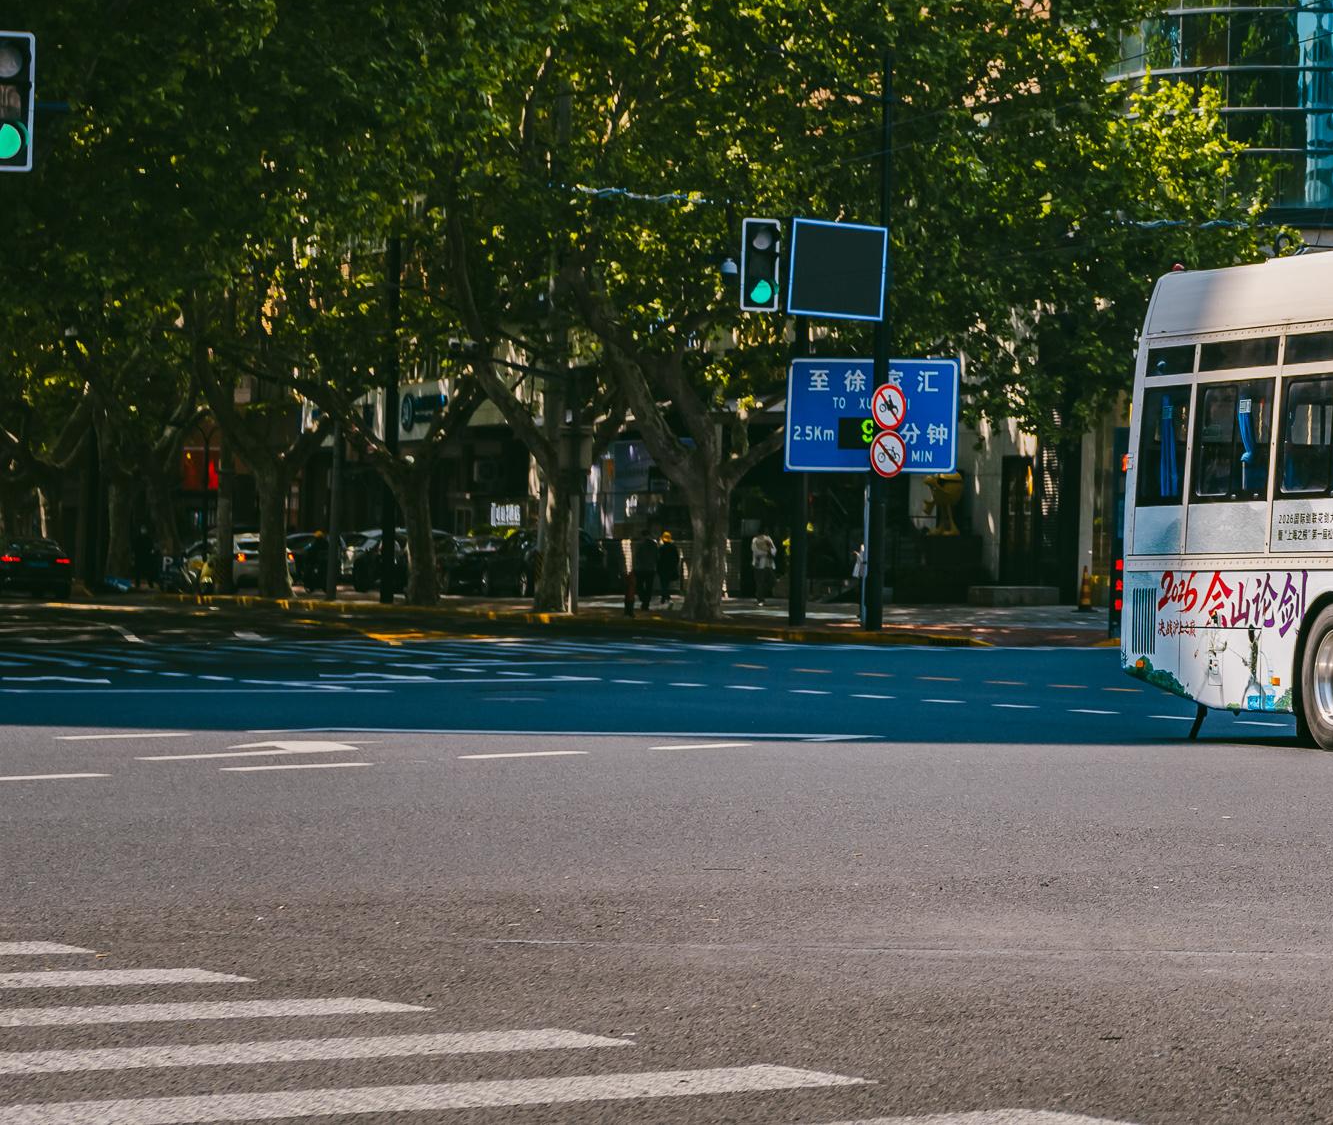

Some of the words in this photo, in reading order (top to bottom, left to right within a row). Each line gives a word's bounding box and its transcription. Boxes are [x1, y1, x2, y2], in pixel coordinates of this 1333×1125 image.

[833, 397, 846, 409] TO
[793, 425, 835, 442] 2.5Km
[900, 423, 948, 446] 分钟
[911, 450, 933, 463] MIN
